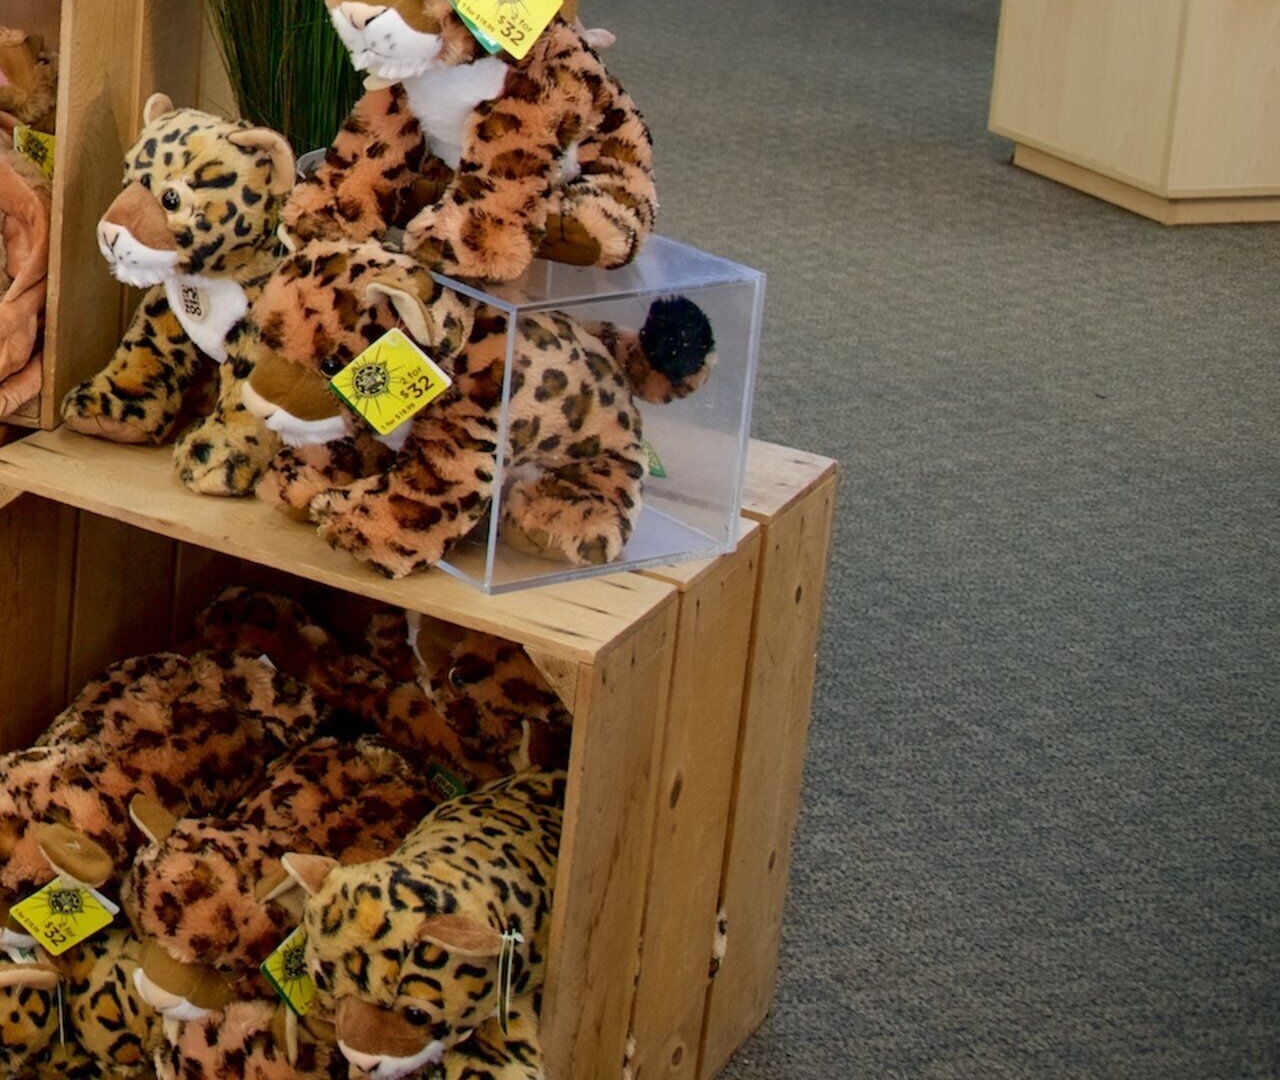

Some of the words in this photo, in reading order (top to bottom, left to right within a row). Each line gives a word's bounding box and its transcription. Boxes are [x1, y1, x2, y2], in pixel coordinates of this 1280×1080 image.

[497, 15, 525, 47] $32
[511, 12, 519, 21] 2
[518, 18, 533, 32] for
[400, 375, 407, 384] 2
[407, 366, 422, 378] for
[399, 375, 434, 400] $32
[44, 921, 66, 946] $32
[64, 925, 75, 938] for
